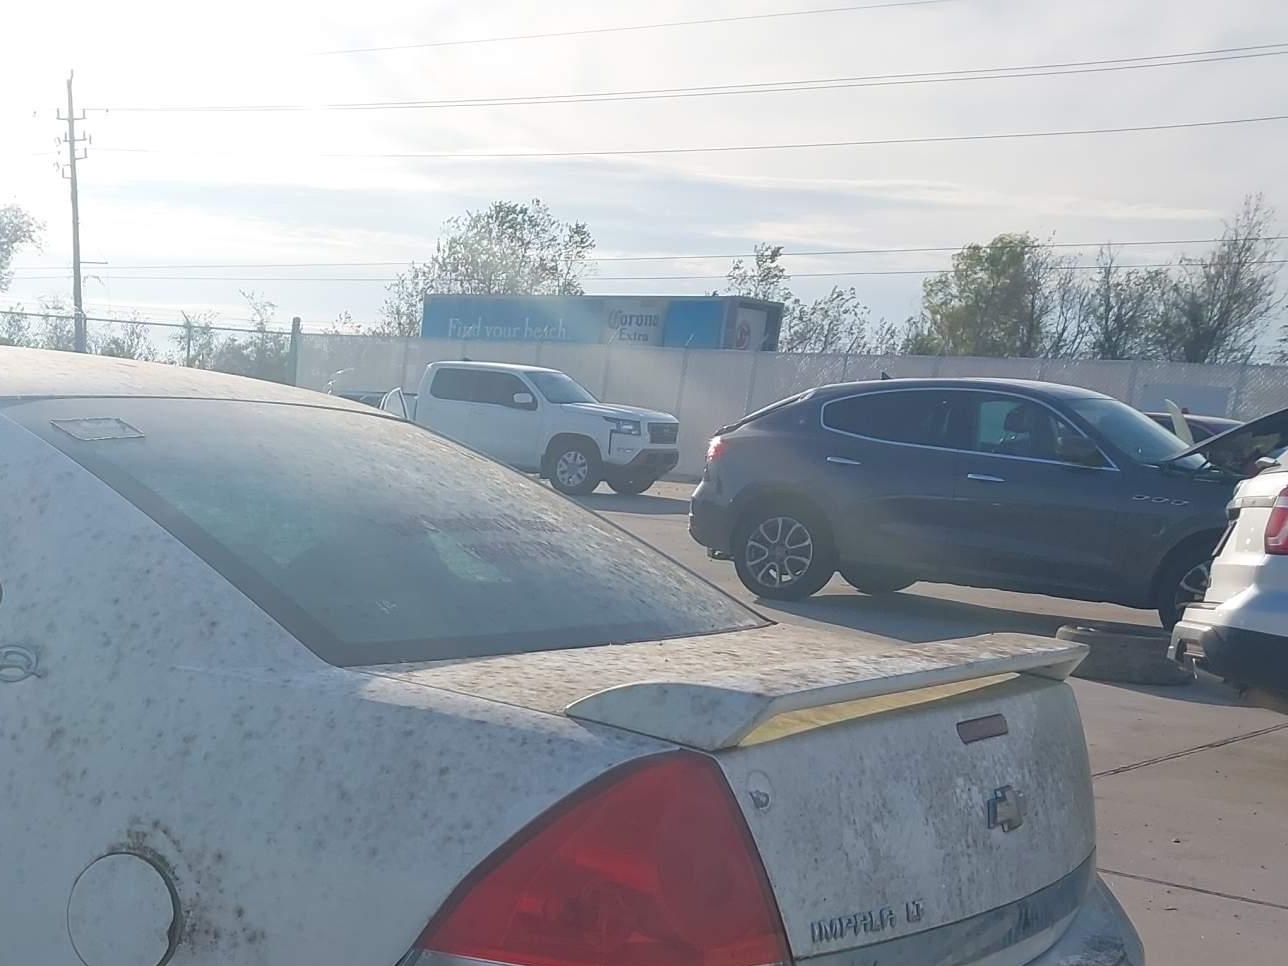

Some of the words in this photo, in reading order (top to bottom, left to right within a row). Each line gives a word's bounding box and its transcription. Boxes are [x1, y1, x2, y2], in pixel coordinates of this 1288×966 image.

[448, 317, 481, 338] Find
[483, 325, 521, 338] your
[619, 327, 649, 341] Extra
[810, 905, 897, 943] IMPALA
[905, 898, 924, 923] LT
